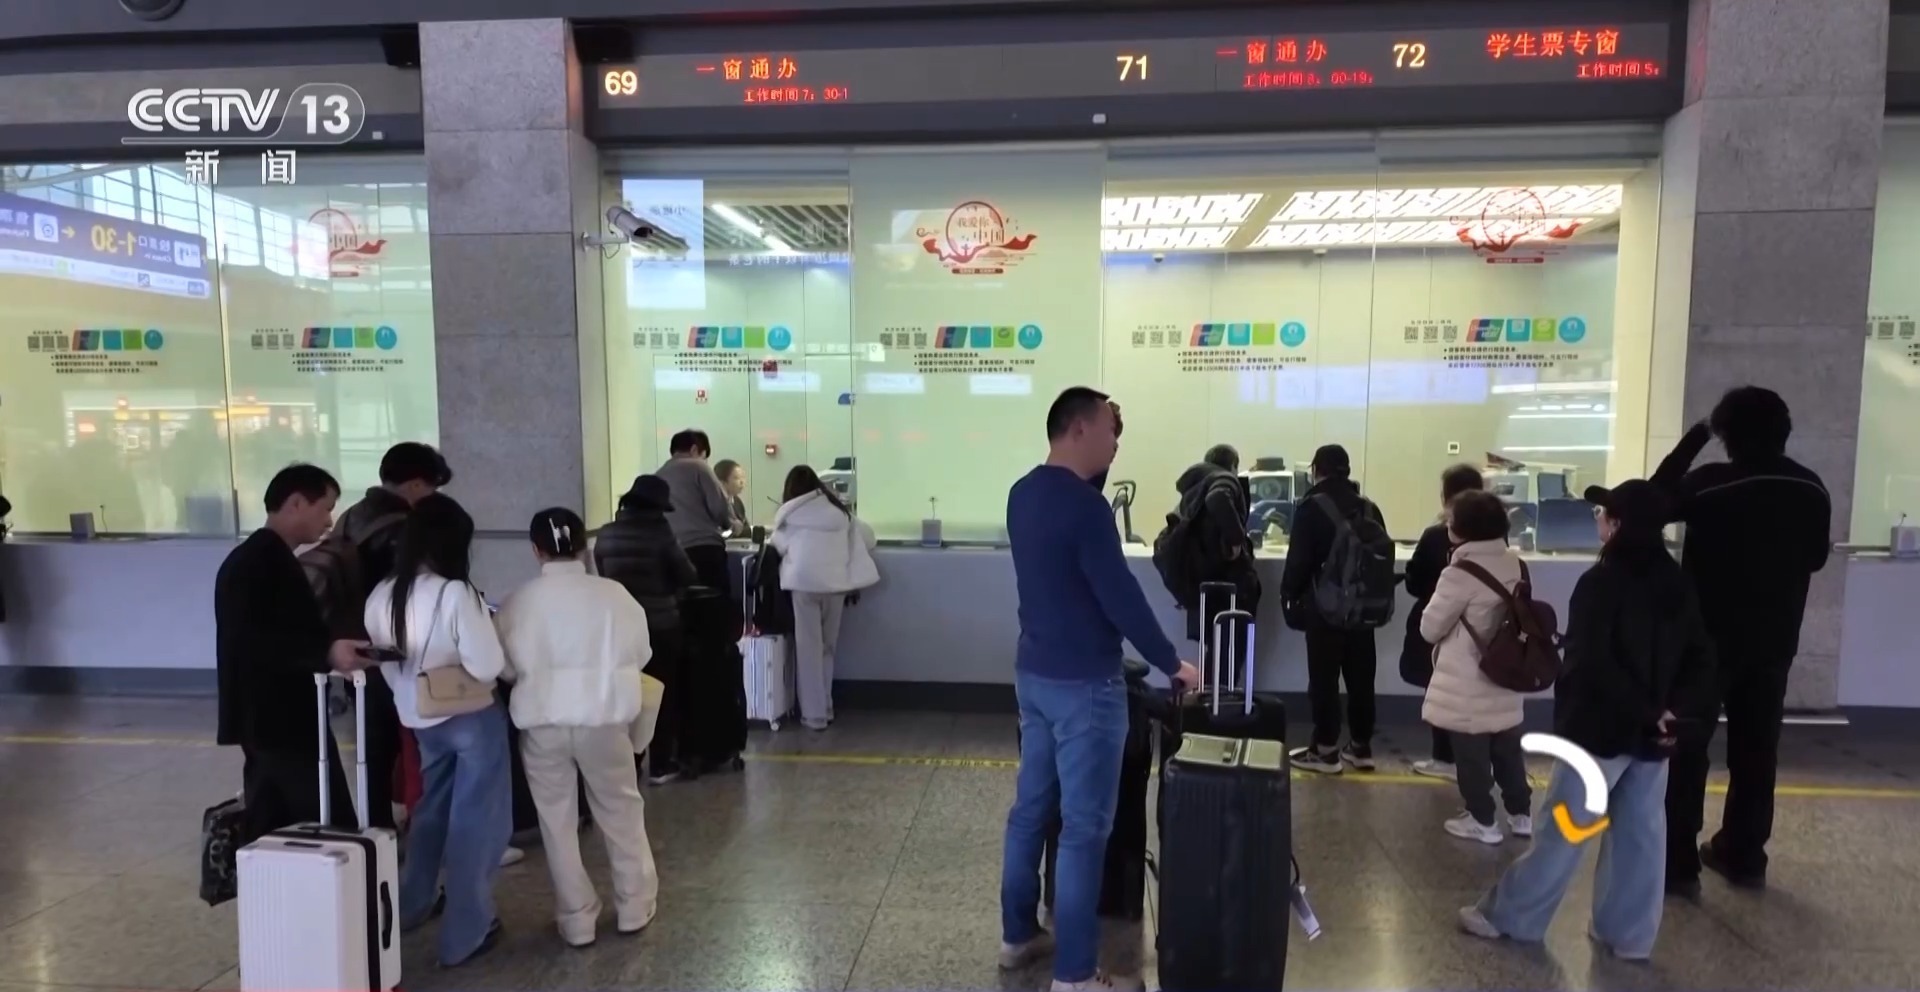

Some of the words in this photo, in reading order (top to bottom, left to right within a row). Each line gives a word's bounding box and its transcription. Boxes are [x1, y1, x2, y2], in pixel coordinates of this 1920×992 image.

[1216, 40, 1327, 65] 一窗通办
[1393, 43, 1426, 68] 72
[1487, 30, 1619, 59] 学生票专窗
[696, 57, 797, 80] 一窗通办
[1116, 55, 1148, 81] 71
[604, 70, 638, 96] 69
